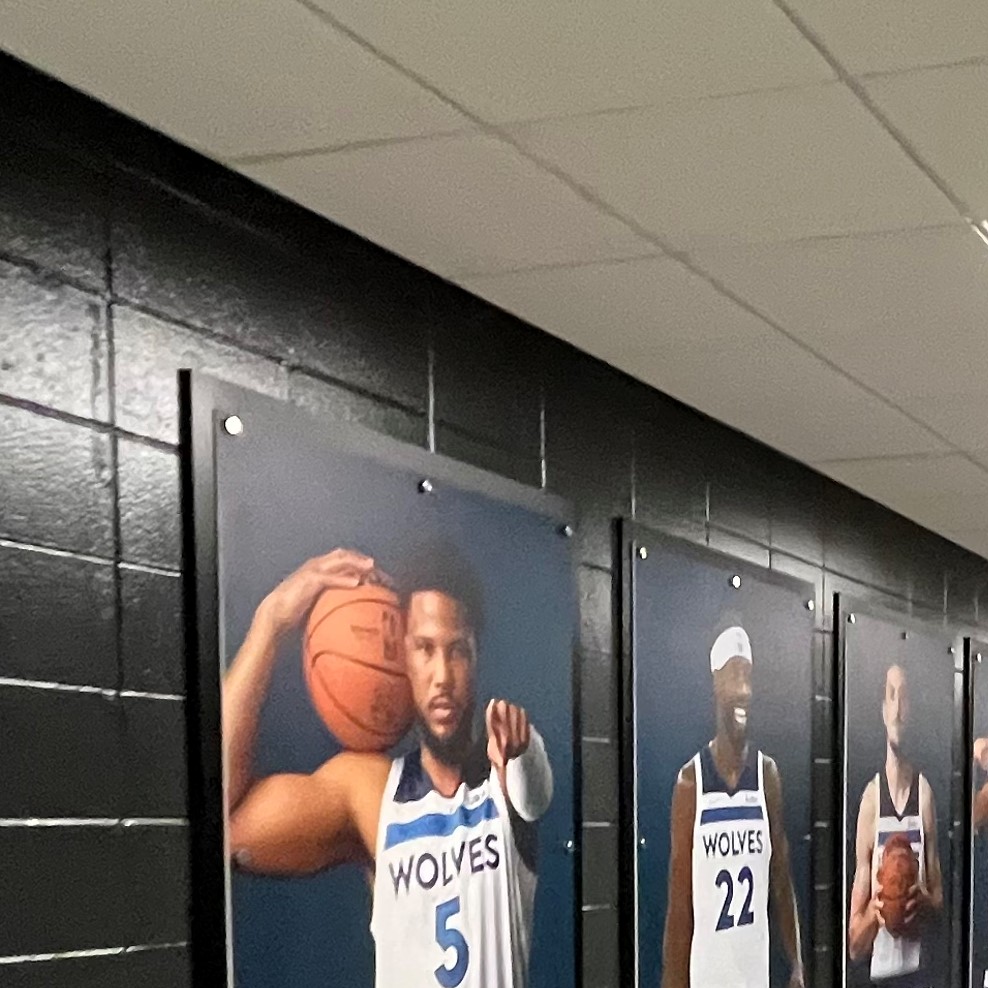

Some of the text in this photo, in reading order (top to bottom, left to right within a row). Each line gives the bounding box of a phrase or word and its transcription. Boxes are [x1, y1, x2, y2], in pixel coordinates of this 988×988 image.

[389, 833, 500, 899] WOLVES
[702, 830, 763, 857] WOLVES
[715, 865, 754, 932] 22
